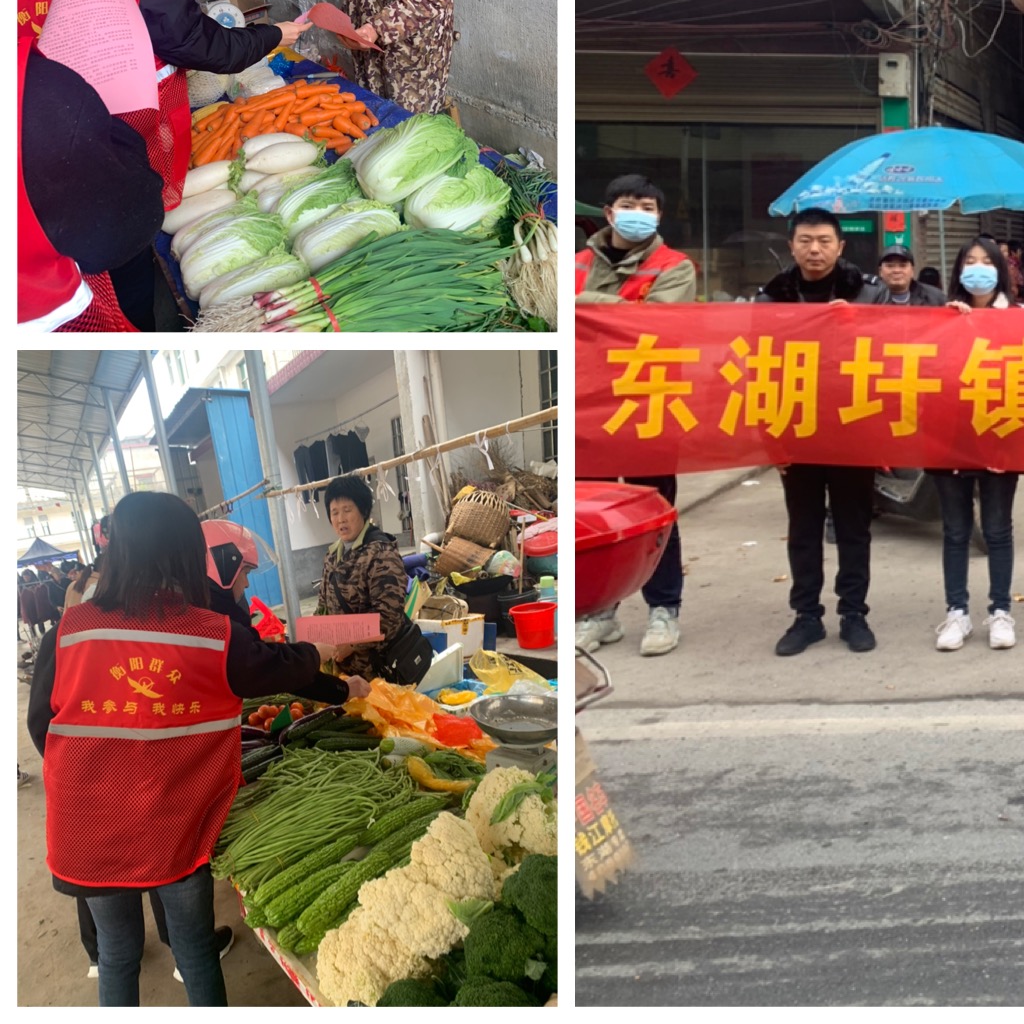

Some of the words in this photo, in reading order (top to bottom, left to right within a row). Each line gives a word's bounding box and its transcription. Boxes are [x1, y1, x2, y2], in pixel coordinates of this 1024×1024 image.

[109, 656, 182, 684] 衡阳群众
[81, 699, 138, 715] 我参与
[152, 701, 201, 716] 我快乐
